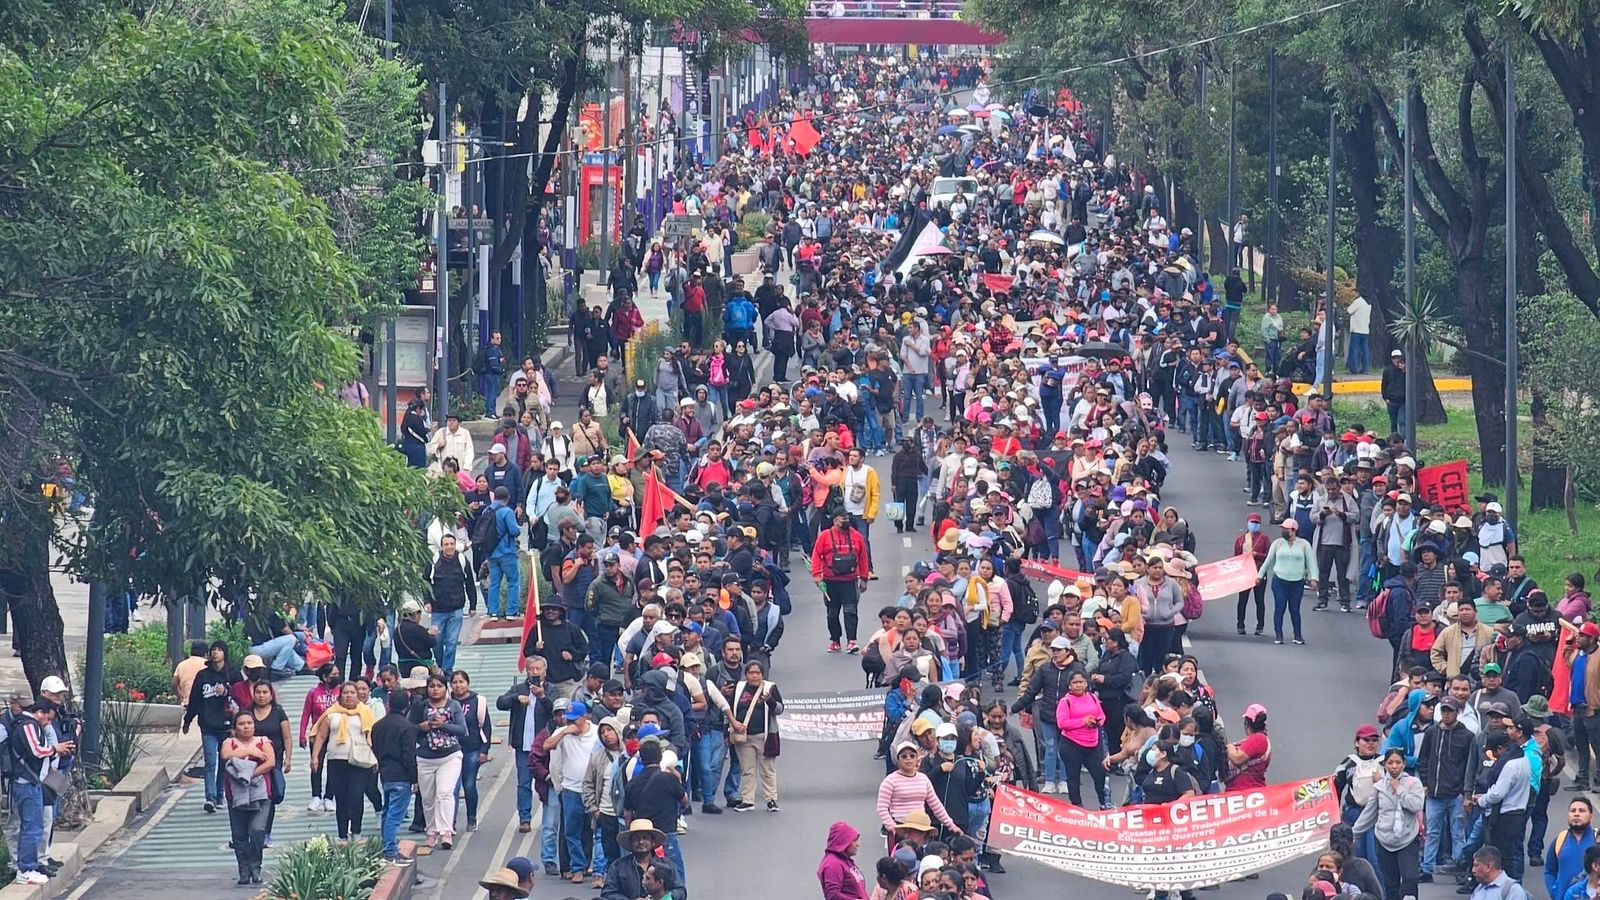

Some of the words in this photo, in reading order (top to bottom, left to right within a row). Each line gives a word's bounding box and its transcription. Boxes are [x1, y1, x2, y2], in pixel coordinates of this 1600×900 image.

[1526, 622, 1555, 634] SAVAGE
[837, 694, 874, 703] TRABAJADORES
[790, 712, 857, 722] MONTAÑA
[858, 711, 884, 722] ALT
[1170, 792, 1265, 825] CETEG
[1174, 825, 1188, 833] los
[1192, 812, 1253, 831] Trabajadores
[1255, 808, 1267, 817] de
[1270, 807, 1278, 816] la
[999, 822, 1135, 854] DELEGACIÓN
[1222, 811, 1330, 847] ACATEPEC
[1172, 829, 1215, 840] Guerrero
[1194, 851, 1217, 859] DEL
